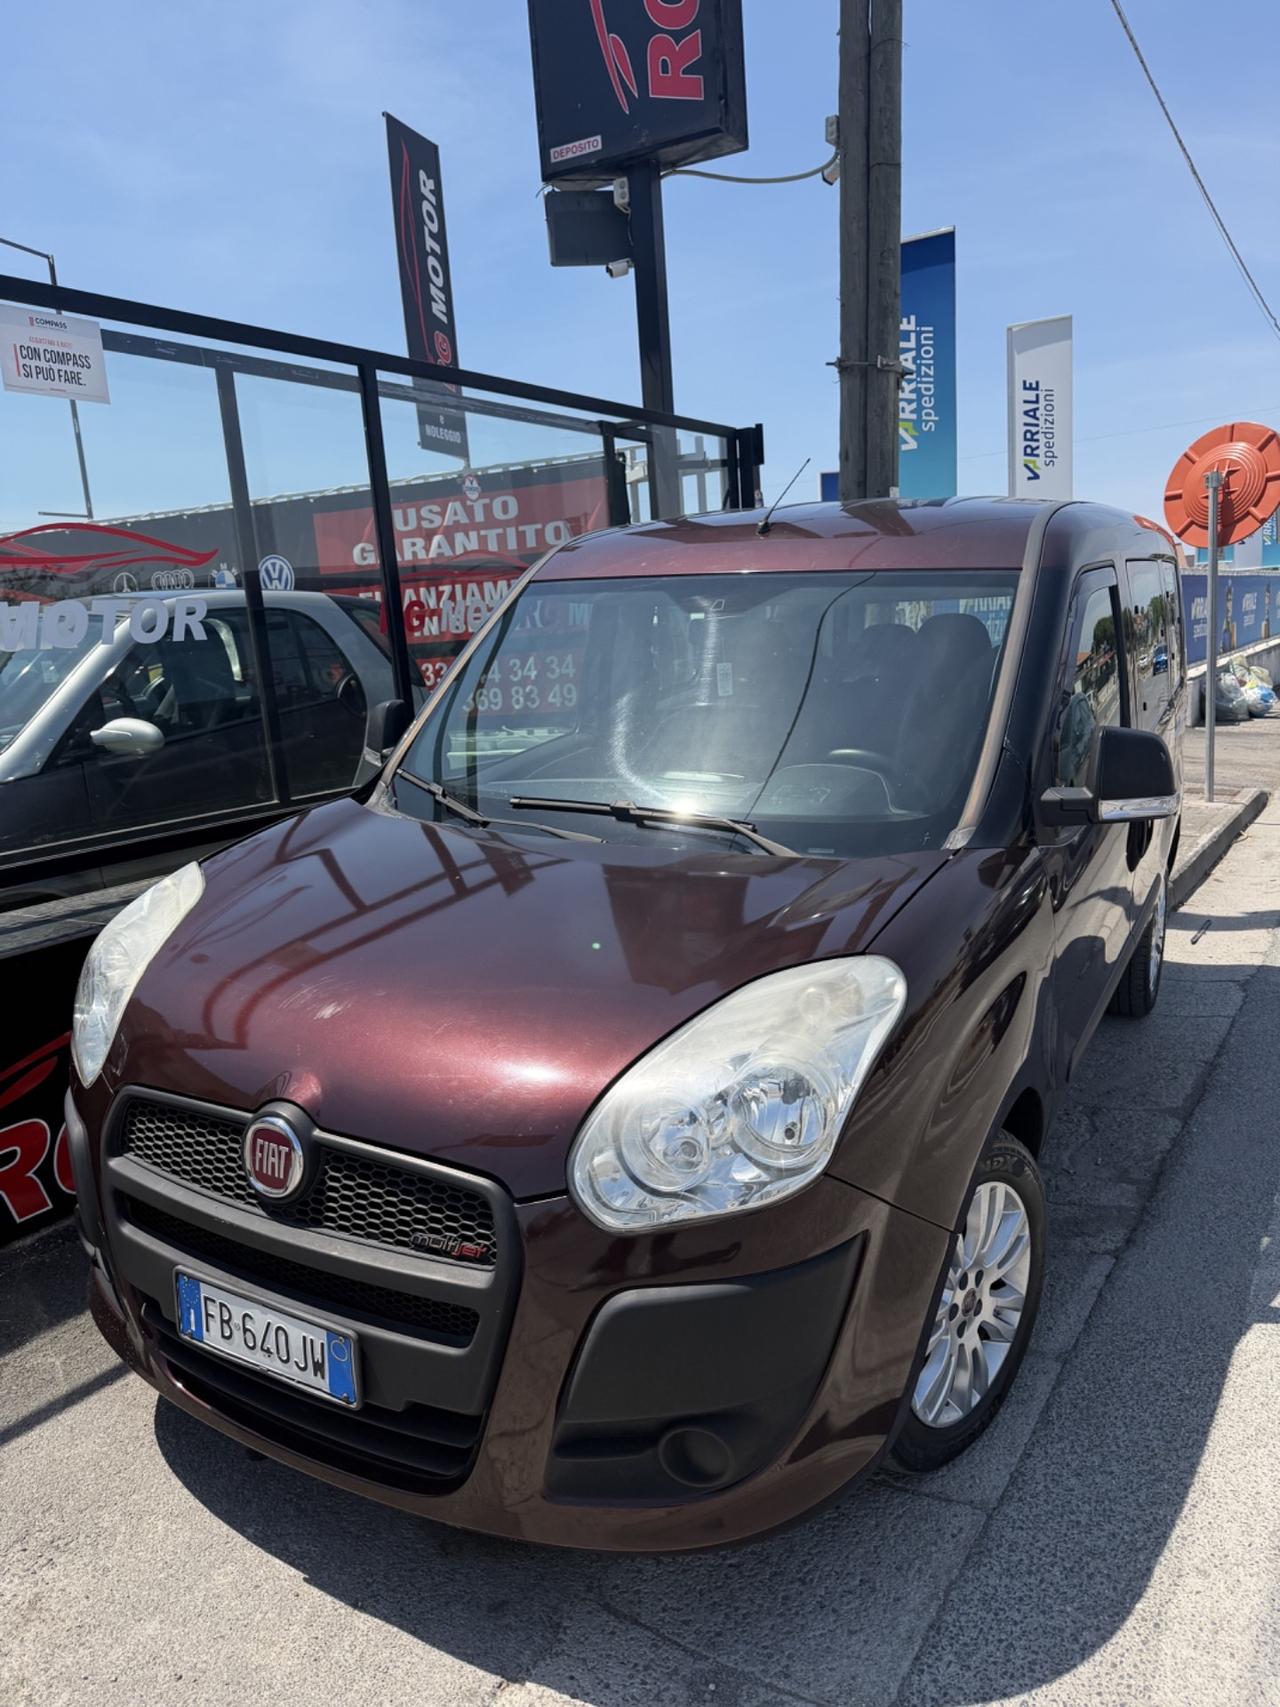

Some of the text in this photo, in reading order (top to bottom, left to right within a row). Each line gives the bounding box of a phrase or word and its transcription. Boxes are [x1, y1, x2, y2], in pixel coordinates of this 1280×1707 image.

[552, 137, 600, 161] DEPOSITO
[418, 169, 449, 324] MOTOR
[35, 317, 68, 330] COMPASS
[19, 344, 92, 369] CON COMPASS
[22, 363, 87, 387] SI PUÒ FARE.
[916, 326, 939, 432] spedizioni
[424, 423, 462, 444] NOLEGGIO
[1040, 388, 1058, 467] spedizioni
[393, 495, 519, 532] USATO
[352, 520, 570, 566] GRANTITO
[509, 655, 538, 681] 34
[546, 653, 576, 679] 34
[511, 684, 540, 710] 83
[548, 683, 577, 708] 49
[254, 1138, 290, 1180] FIAT
[203, 1295, 233, 1341] FB
